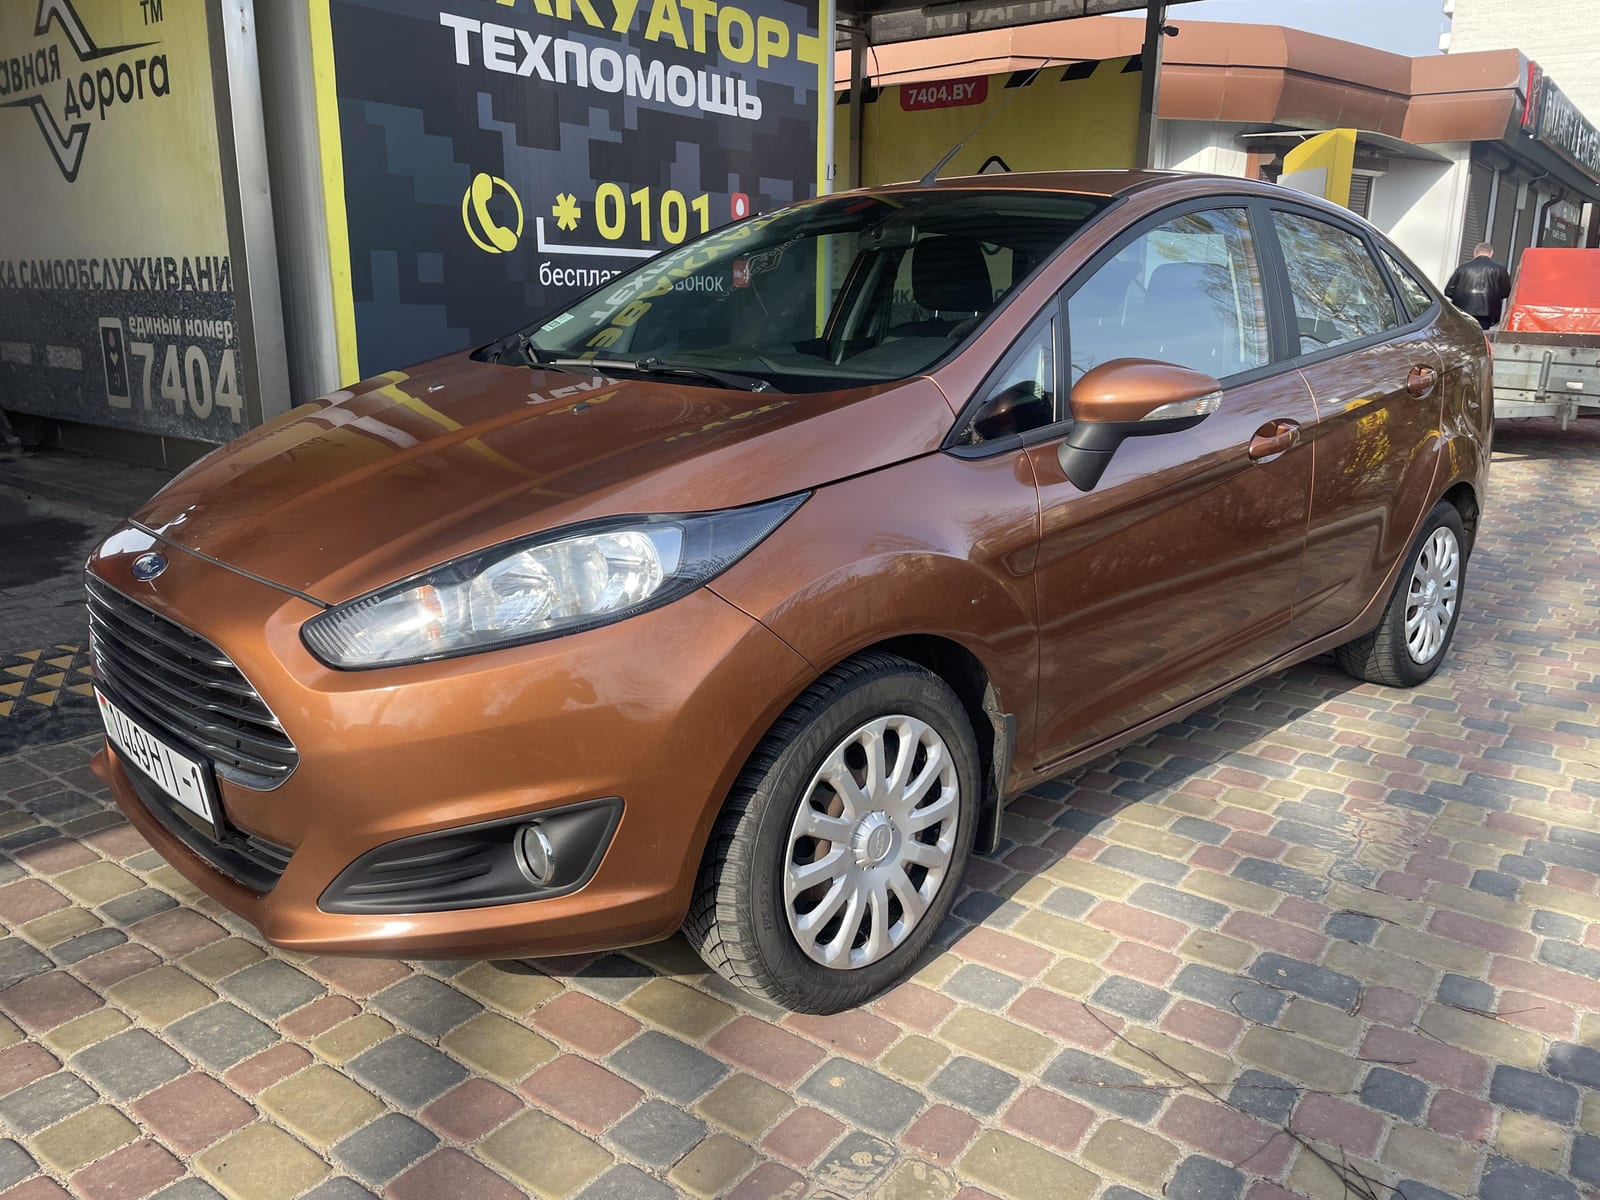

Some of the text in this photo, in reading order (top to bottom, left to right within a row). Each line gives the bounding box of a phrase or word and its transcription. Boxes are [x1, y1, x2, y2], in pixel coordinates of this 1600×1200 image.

[64, 54, 170, 121] дорога
[439, 12, 763, 120] ТЕХПОМОЩЬ
[908, 81, 977, 105] 7404.BY
[129, 317, 233, 346] единый номер
[130, 342, 244, 424] 7404
